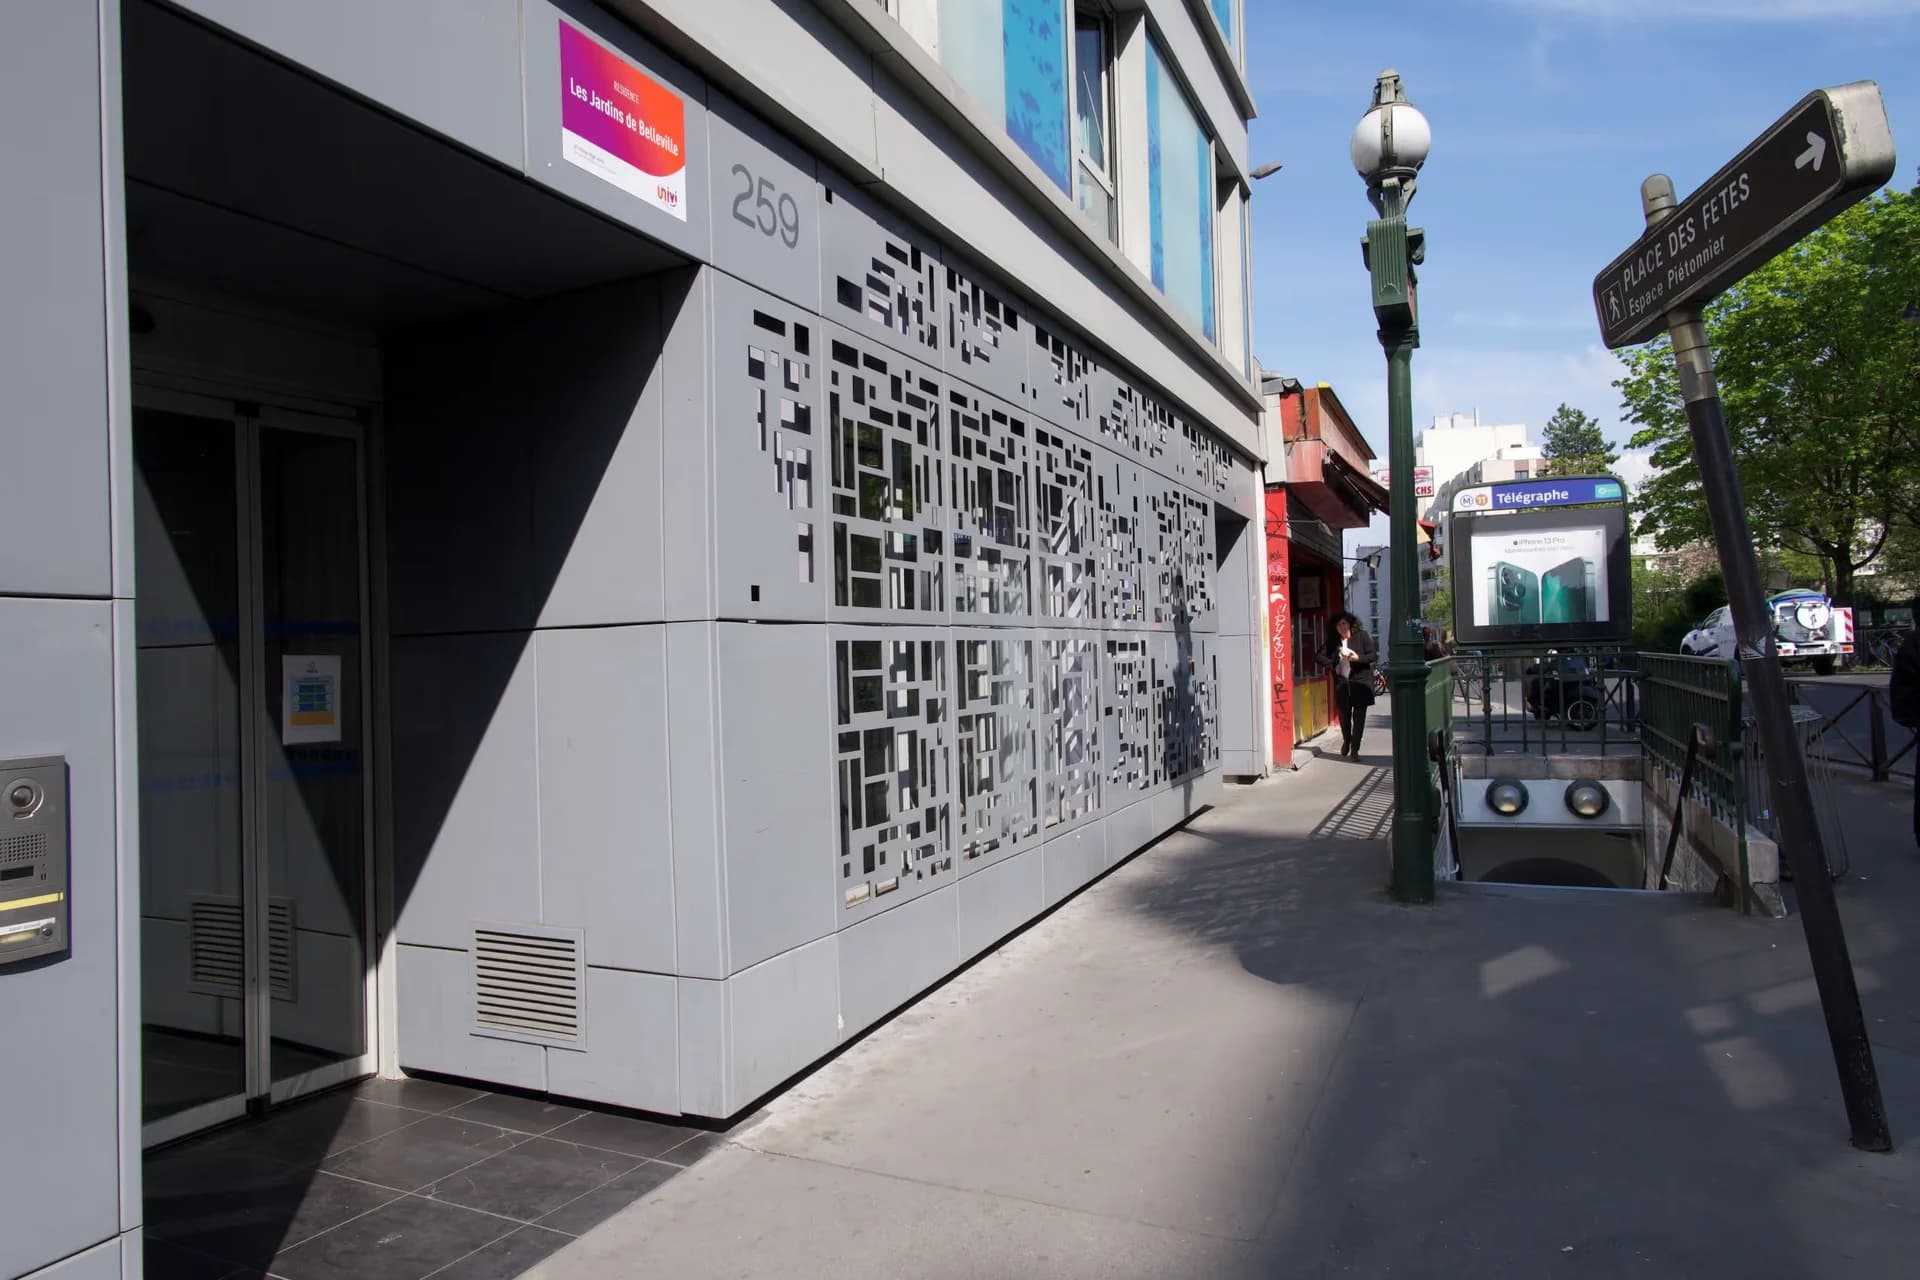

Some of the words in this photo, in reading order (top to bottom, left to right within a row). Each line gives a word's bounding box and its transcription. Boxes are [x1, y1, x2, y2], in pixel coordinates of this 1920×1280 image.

[570, 77, 588, 102] Les
[589, 90, 624, 124] Jardins
[625, 113, 637, 132] de
[638, 119, 679, 157] Belleville
[731, 163, 800, 249] 259
[1623, 242, 1664, 292] PLACE
[1668, 216, 1696, 258] DES
[1701, 172, 1750, 231] FETES
[1628, 284, 1664, 318] Espace
[1667, 235, 1726, 290] Piétonnier
[1496, 489, 1569, 506] Télégraphe
